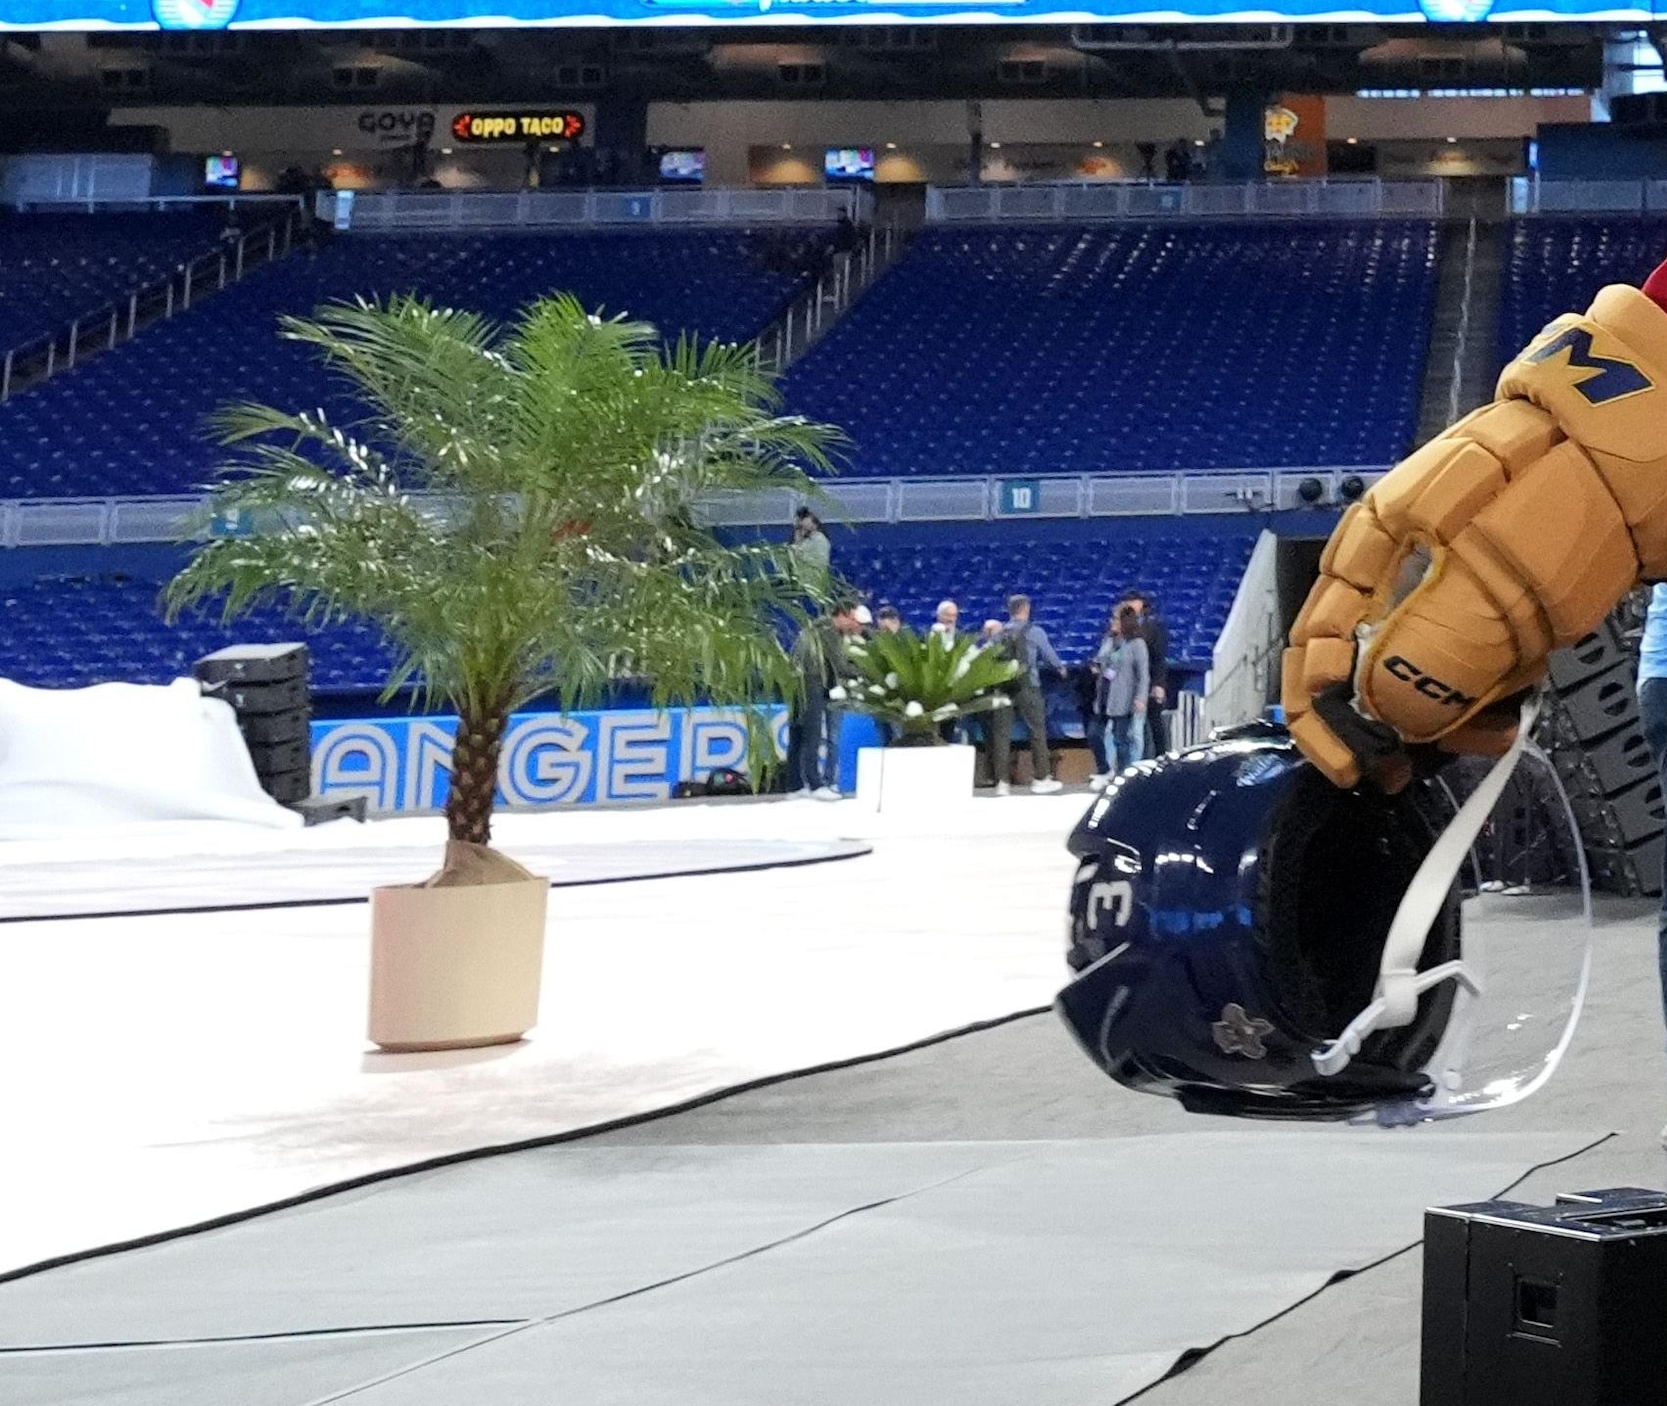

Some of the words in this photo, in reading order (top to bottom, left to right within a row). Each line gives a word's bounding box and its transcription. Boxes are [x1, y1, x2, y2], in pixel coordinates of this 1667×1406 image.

[470, 117, 517, 138] OPPO
[519, 116, 565, 137] TACO
[1011, 486, 1032, 510] 10
